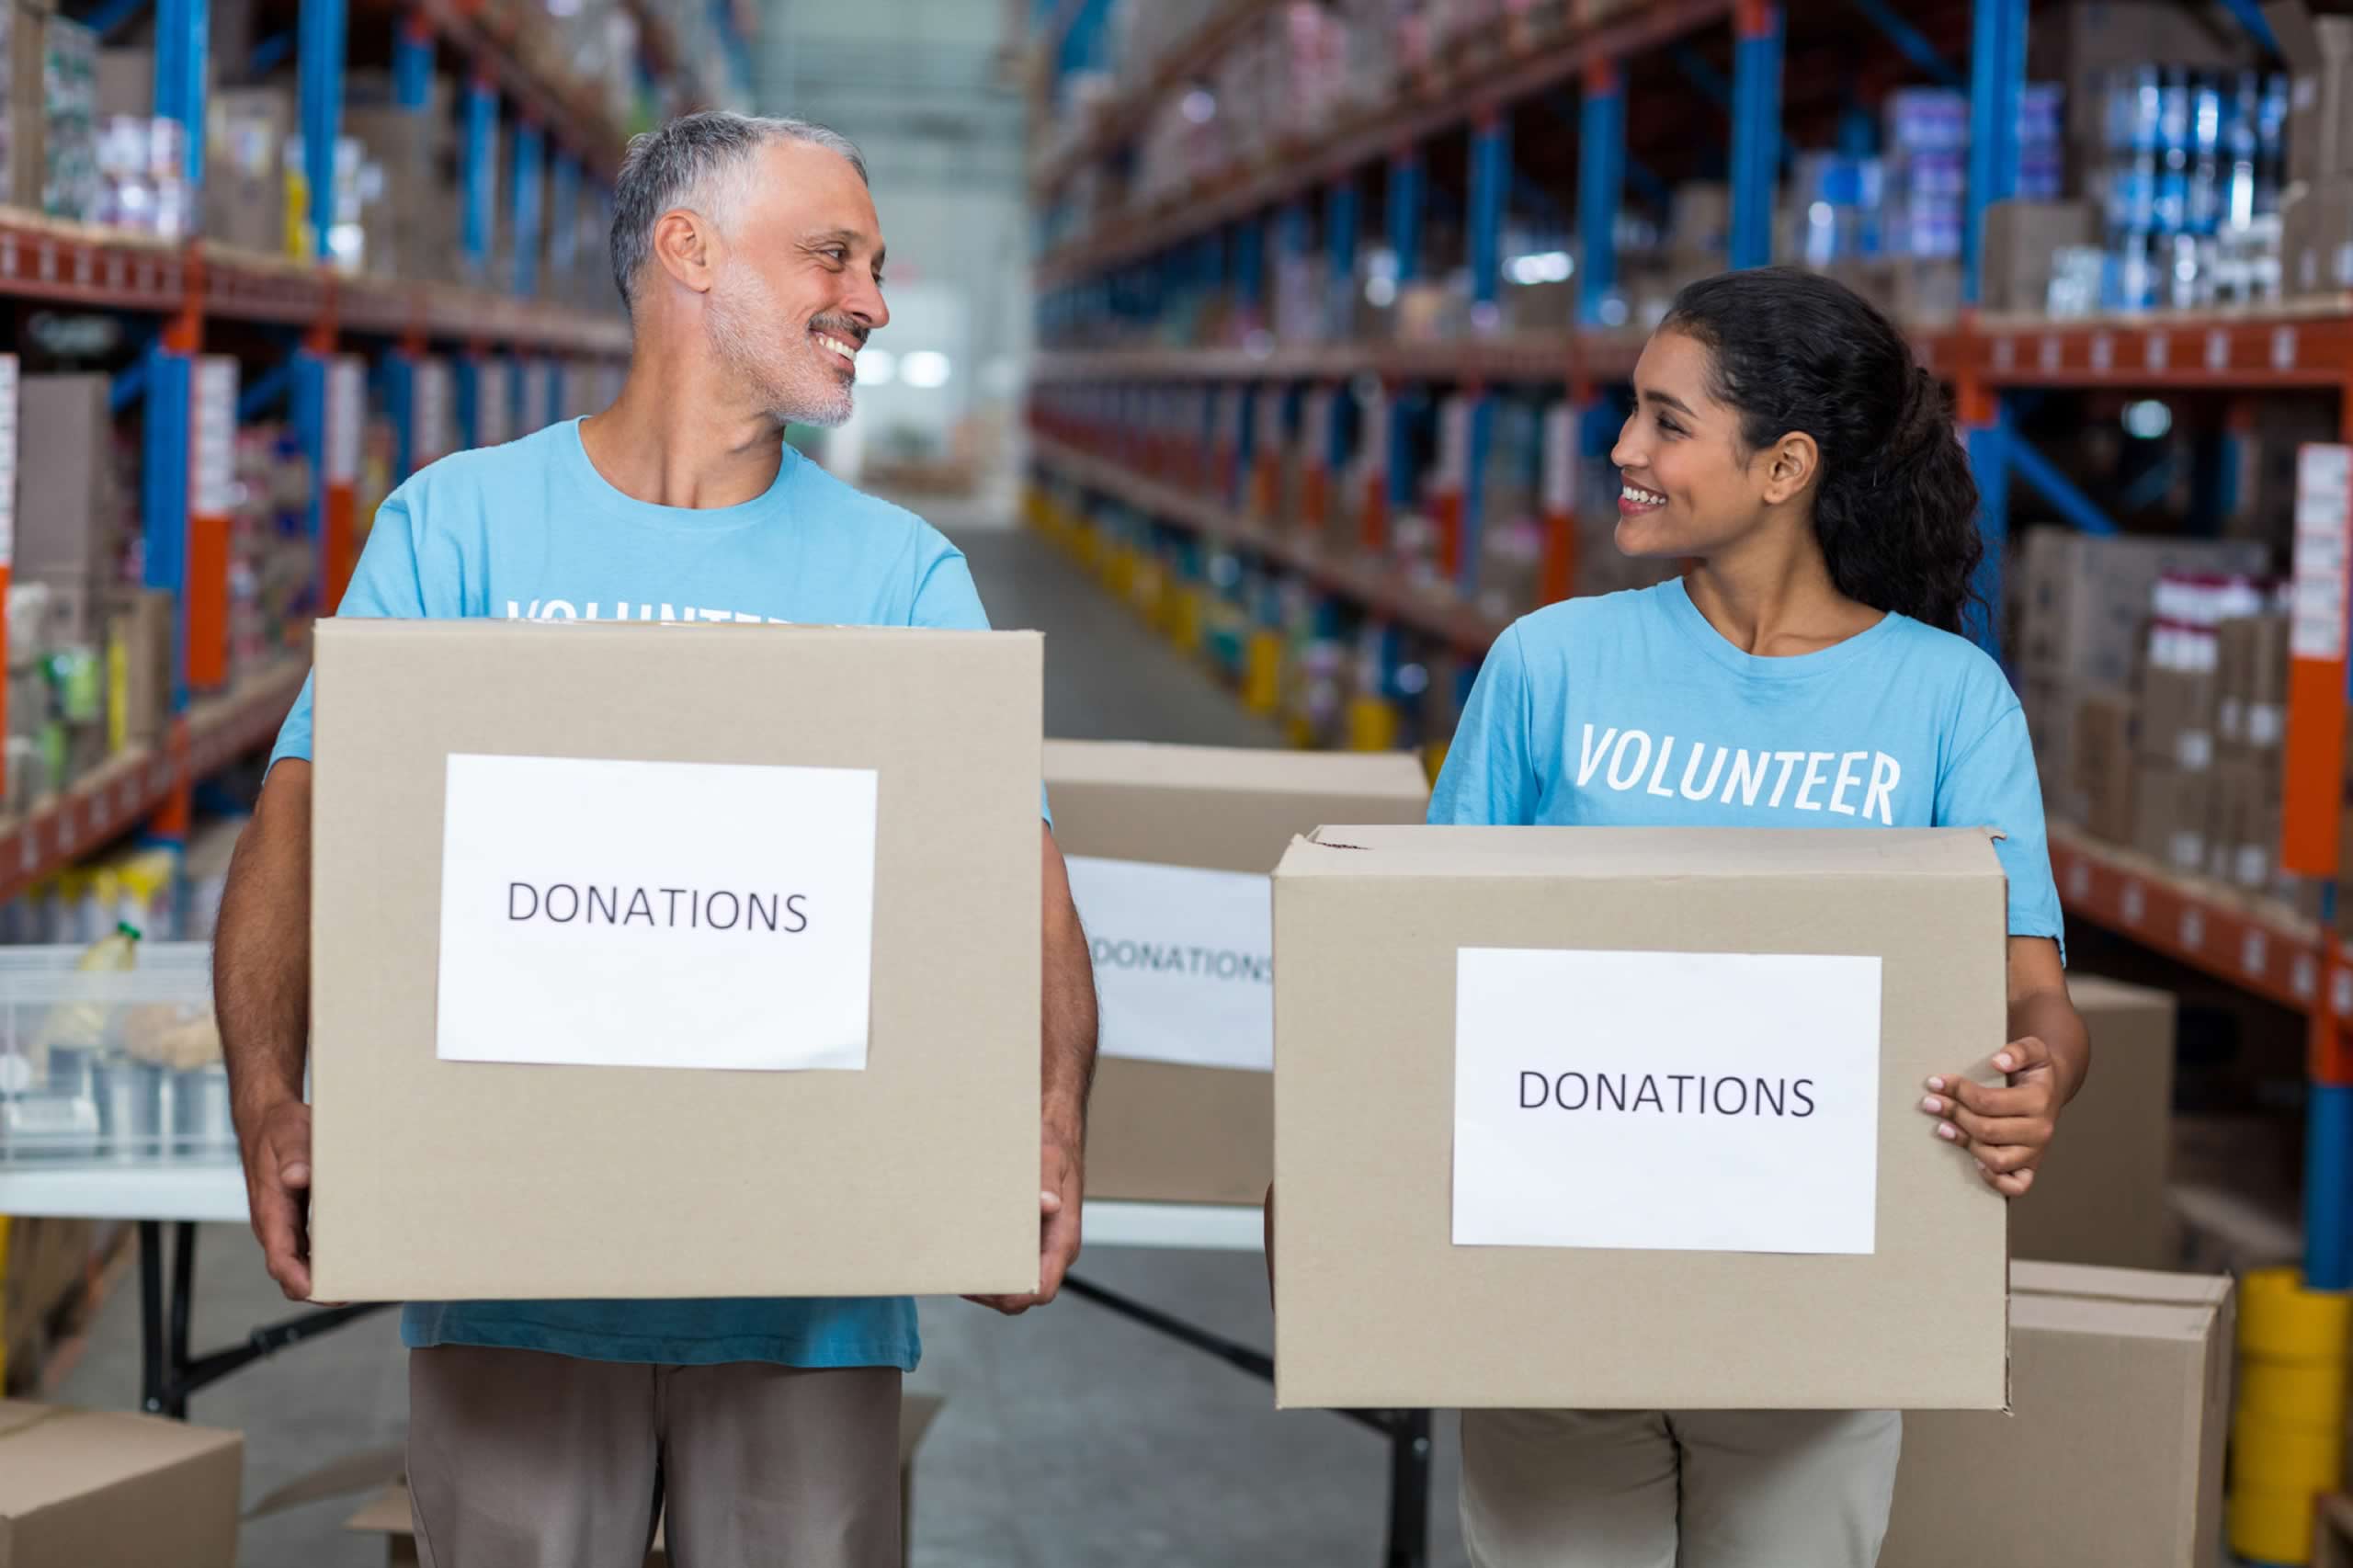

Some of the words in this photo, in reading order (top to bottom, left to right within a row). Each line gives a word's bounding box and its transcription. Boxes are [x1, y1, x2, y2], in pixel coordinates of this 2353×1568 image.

[1576, 723, 1902, 825] VOLUNTEER
[508, 881, 808, 934] DONATIONS
[1519, 1070, 1815, 1119] DONATIONS
